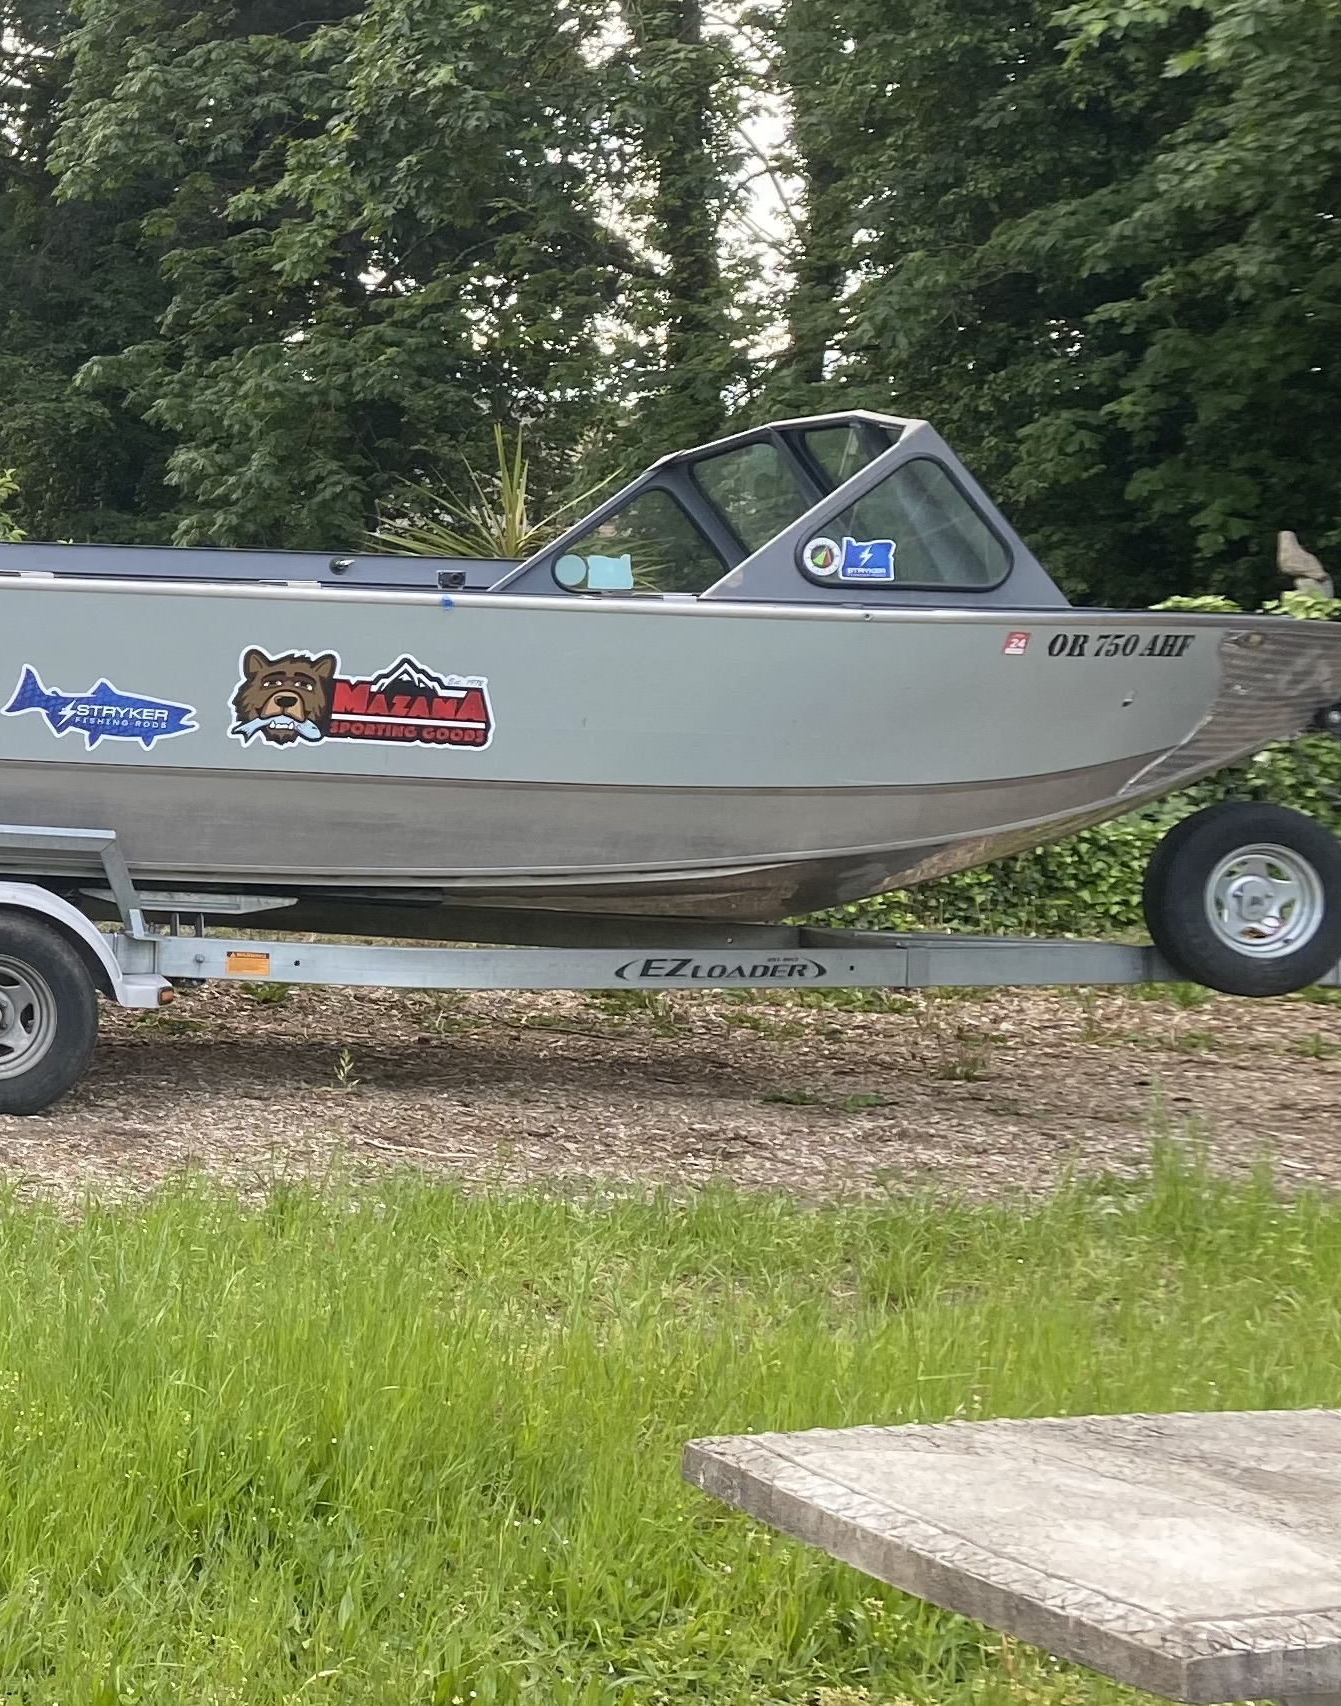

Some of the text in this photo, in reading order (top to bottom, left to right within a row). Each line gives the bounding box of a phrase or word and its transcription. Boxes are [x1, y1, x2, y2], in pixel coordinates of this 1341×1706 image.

[1009, 638, 1026, 649] 24
[1047, 634, 1195, 657] OR 750 AHF
[331, 682, 486, 722] MAZAMA
[76, 704, 169, 721] STRYKER
[75, 716, 167, 729] FISHING RODS
[329, 721, 486, 743] SPORTING GOODS
